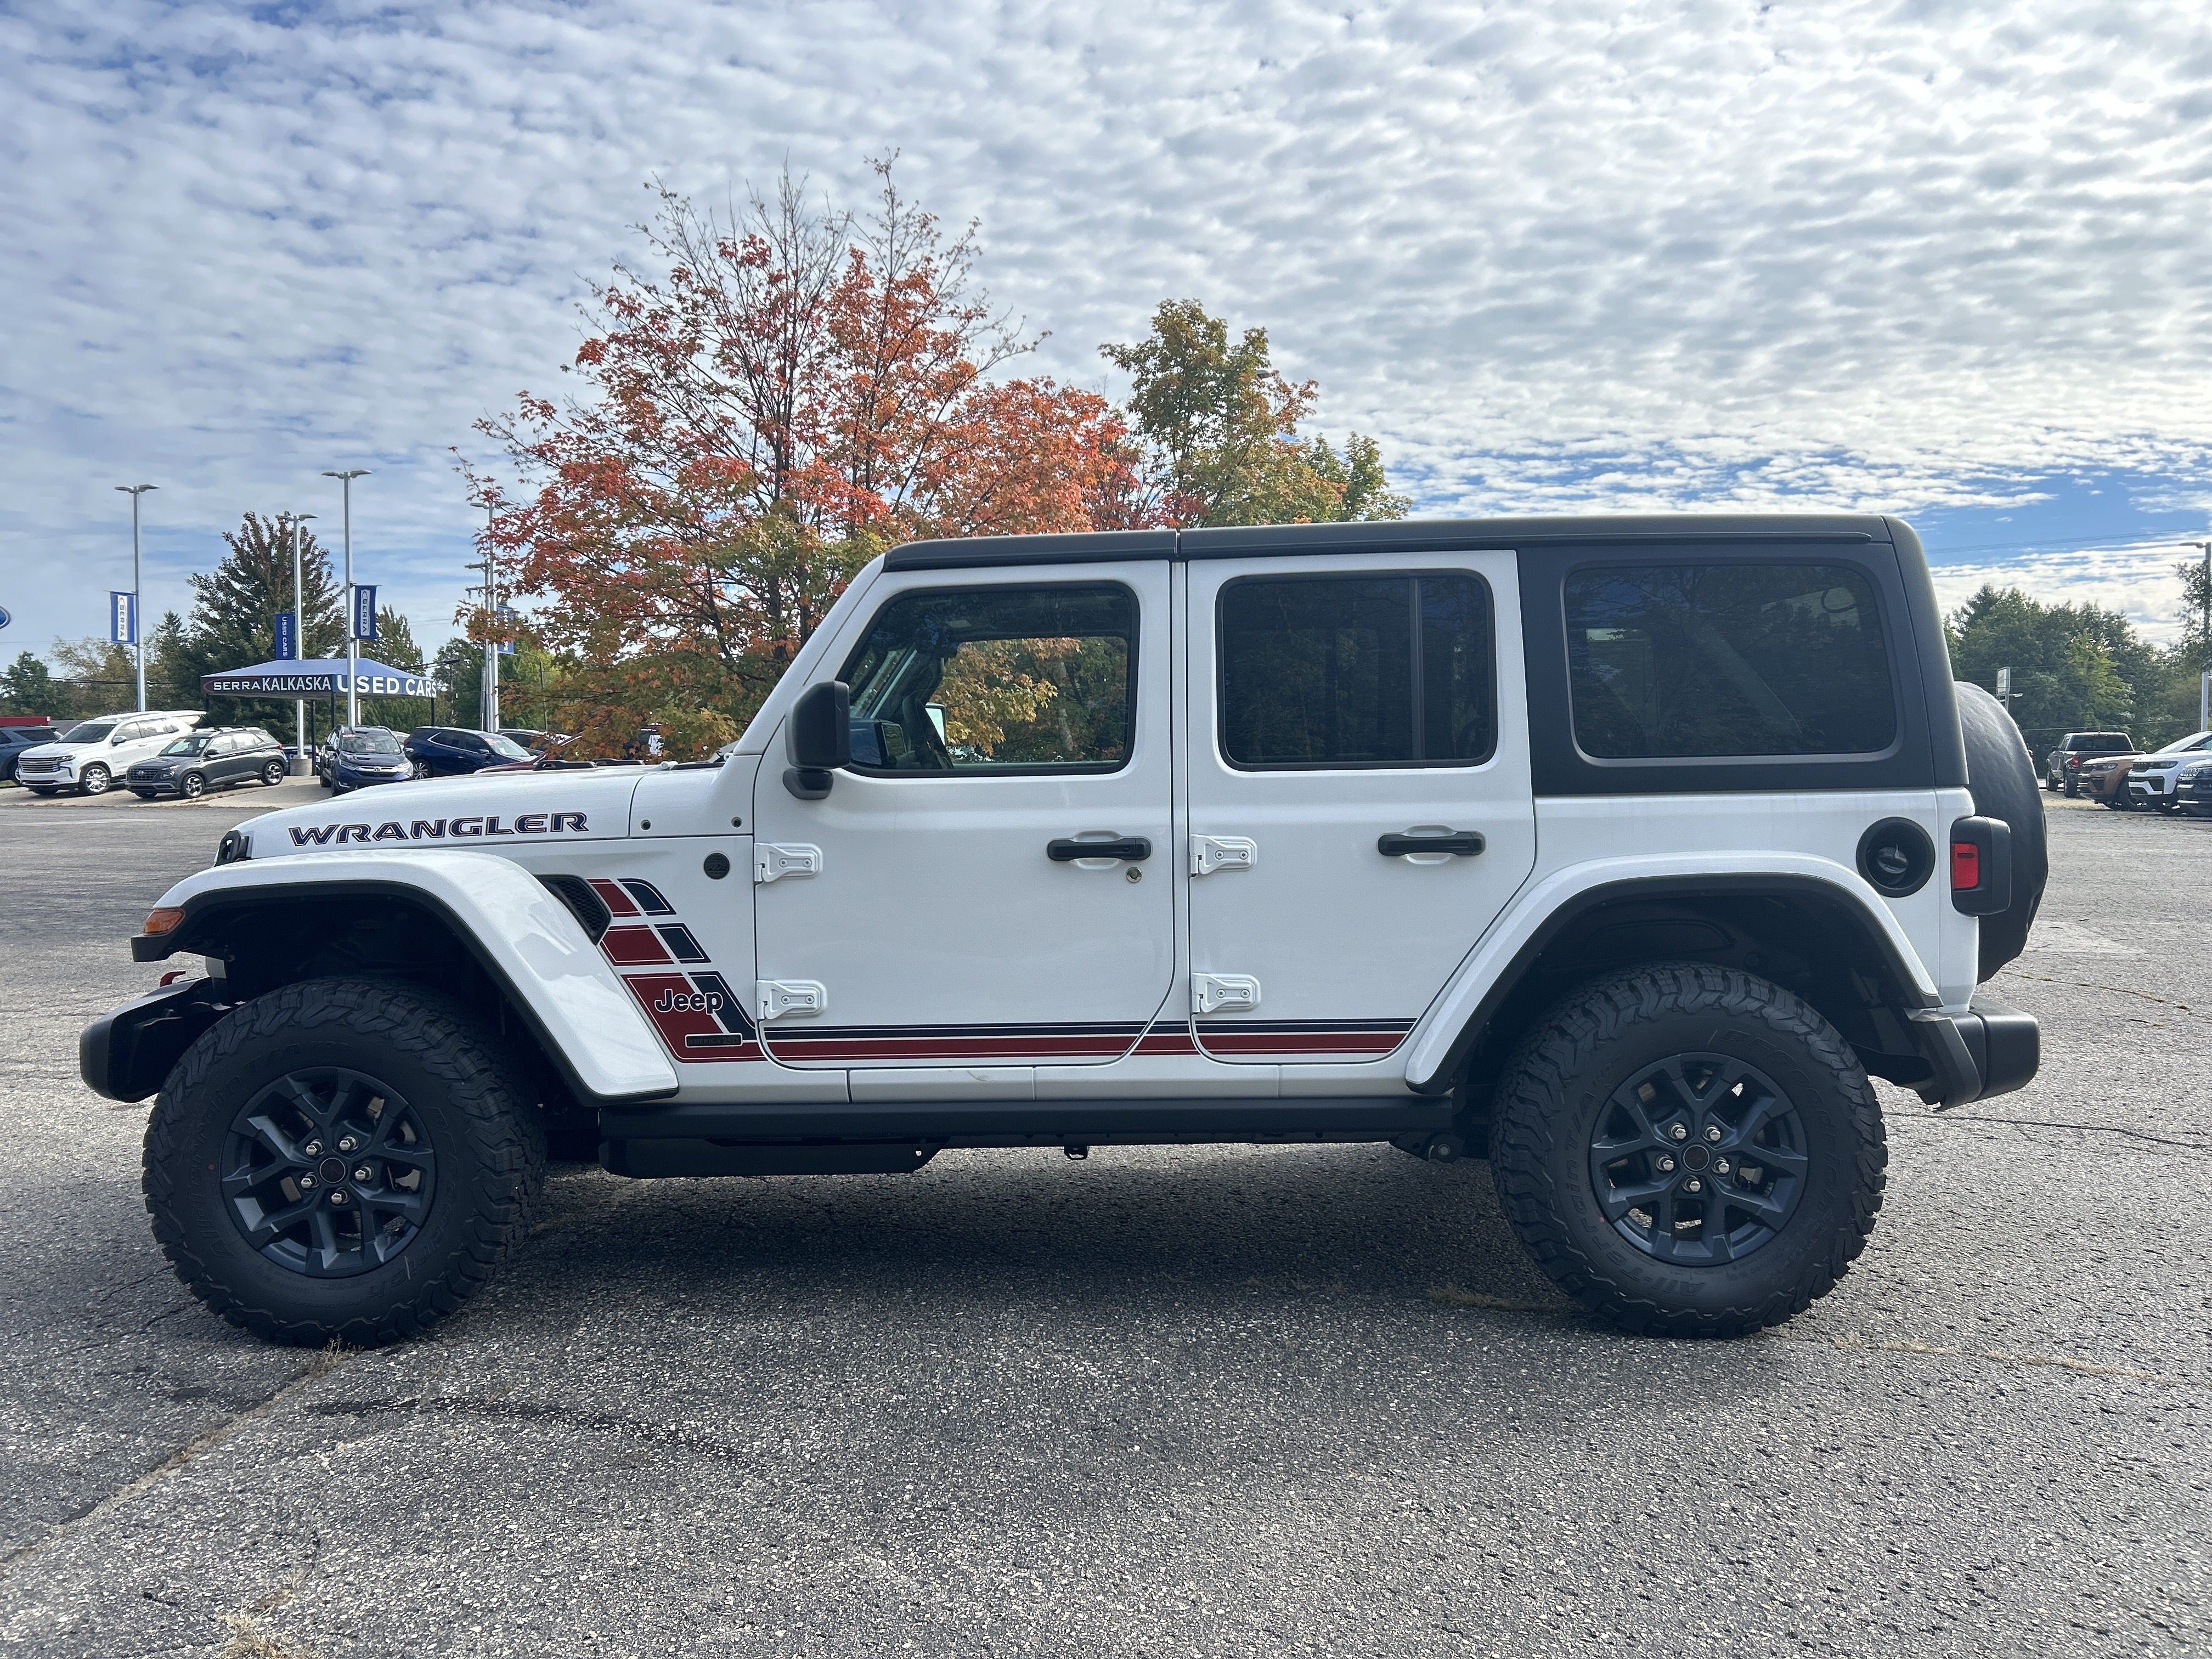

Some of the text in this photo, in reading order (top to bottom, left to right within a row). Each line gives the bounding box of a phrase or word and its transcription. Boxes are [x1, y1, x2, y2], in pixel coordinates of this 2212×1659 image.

[213, 676, 331, 691] SERRA KALKASKA
[337, 674, 437, 698] USED CARS
[287, 812, 589, 847] WRANGLER
[654, 989, 724, 1015] Jeep
